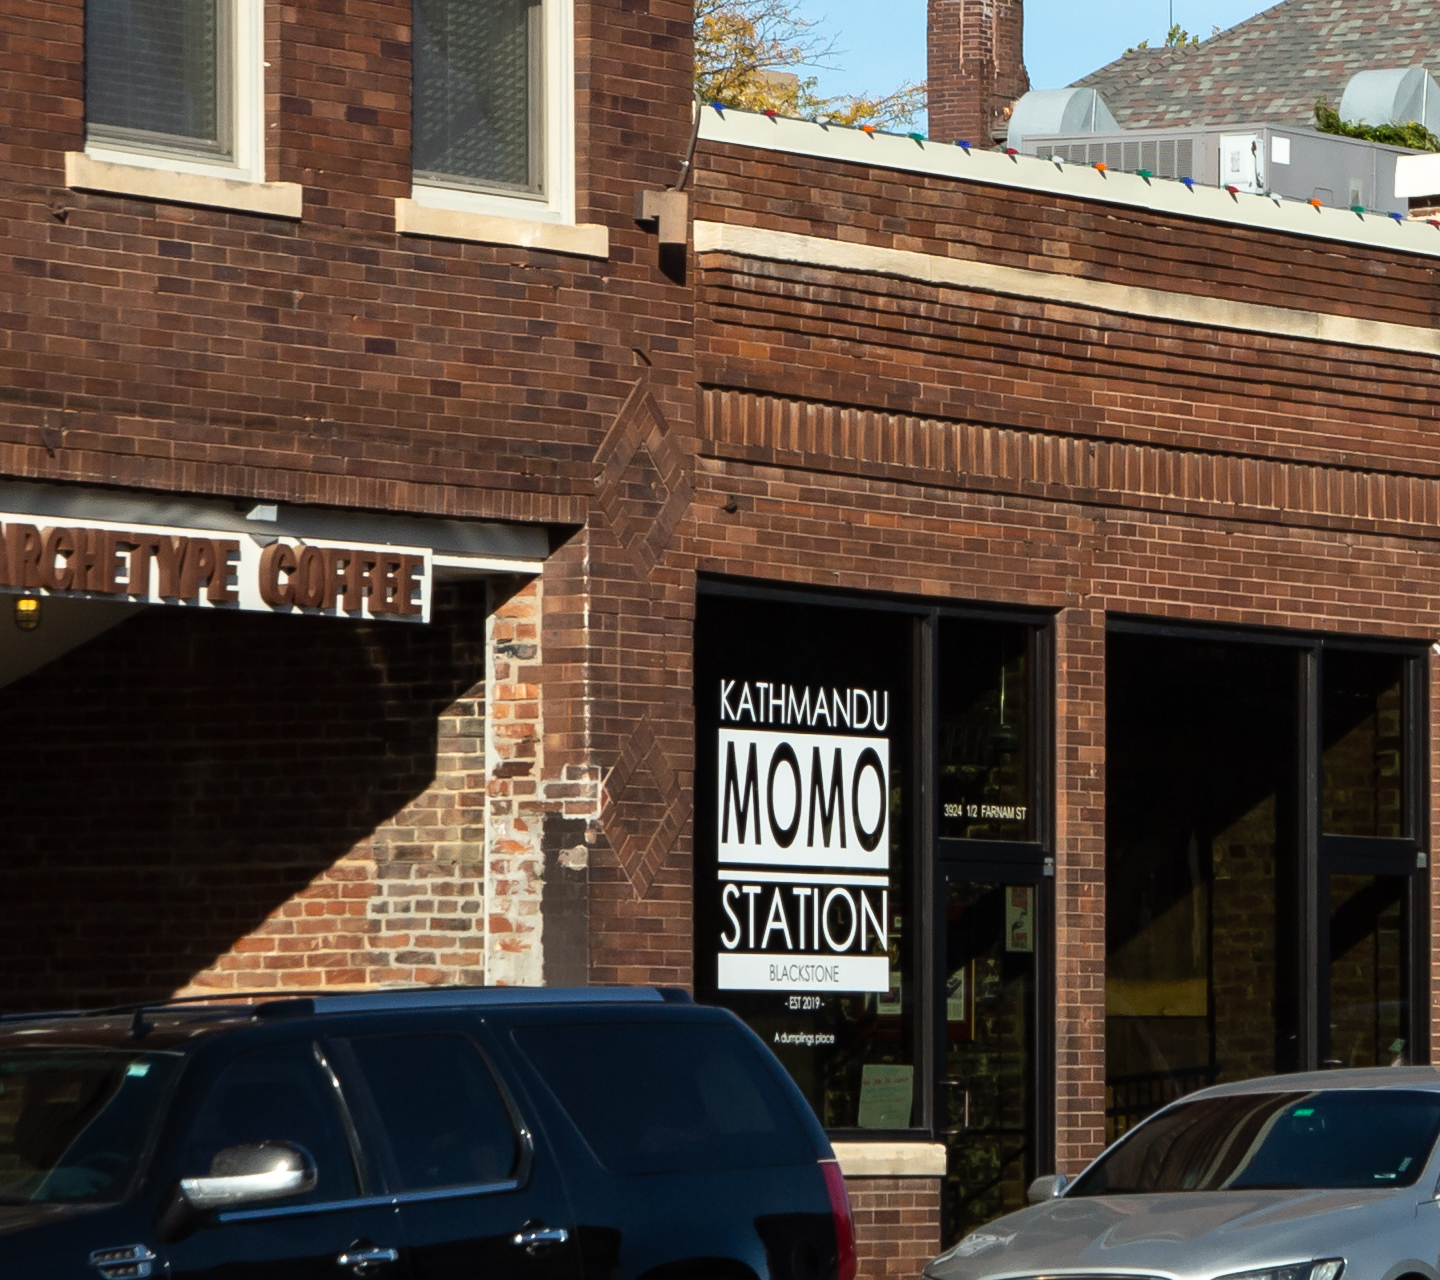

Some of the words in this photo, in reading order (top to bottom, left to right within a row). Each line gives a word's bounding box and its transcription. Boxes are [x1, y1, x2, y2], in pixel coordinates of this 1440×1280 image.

[259, 542, 424, 616] COFFEE
[721, 680, 888, 731] KATHMANDU
[721, 740, 887, 852] MOMO
[944, 803, 962, 817] 3924
[967, 804, 978, 817] 1/2
[981, 805, 1014, 818] FARNAM
[1016, 806, 1026, 820] ST
[721, 884, 888, 952] STATION
[769, 964, 839, 982] BLACKSTONE
